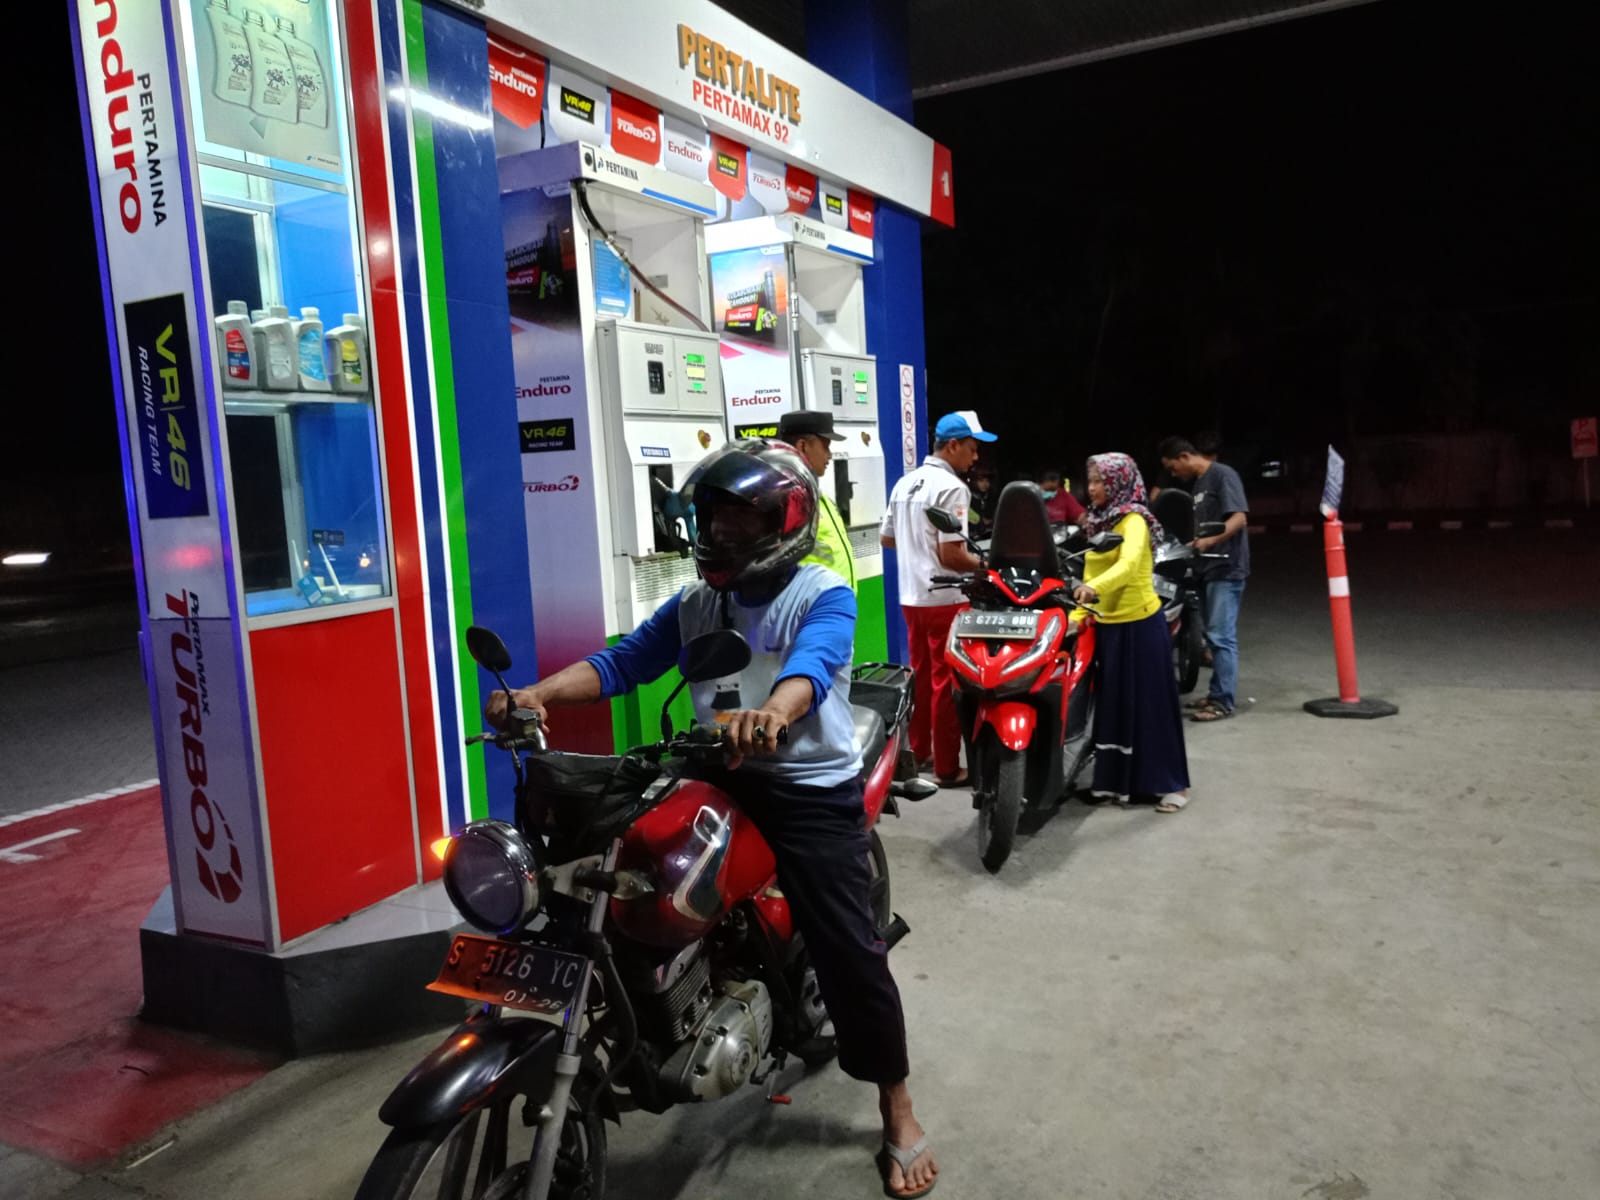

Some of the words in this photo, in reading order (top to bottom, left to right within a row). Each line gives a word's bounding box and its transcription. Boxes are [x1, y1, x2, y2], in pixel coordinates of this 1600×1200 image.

[677, 24, 801, 127] PERTALITE
[693, 80, 771, 137] PERTAMAX
[774, 121, 789, 143] 92
[137, 73, 167, 227] PERTAMINA
[605, 160, 639, 180] PERTAMINA
[667, 141, 702, 162] Enduro
[941, 170, 950, 197] 1
[138, 345, 155, 419] RACING
[147, 425, 161, 476] TEAM
[732, 395, 782, 407] Enduro
[964, 615, 972, 625] S
[165, 588, 215, 851] TURBO
[449, 941, 465, 965] S
[482, 945, 534, 979] 5126
[551, 959, 578, 988] YC
